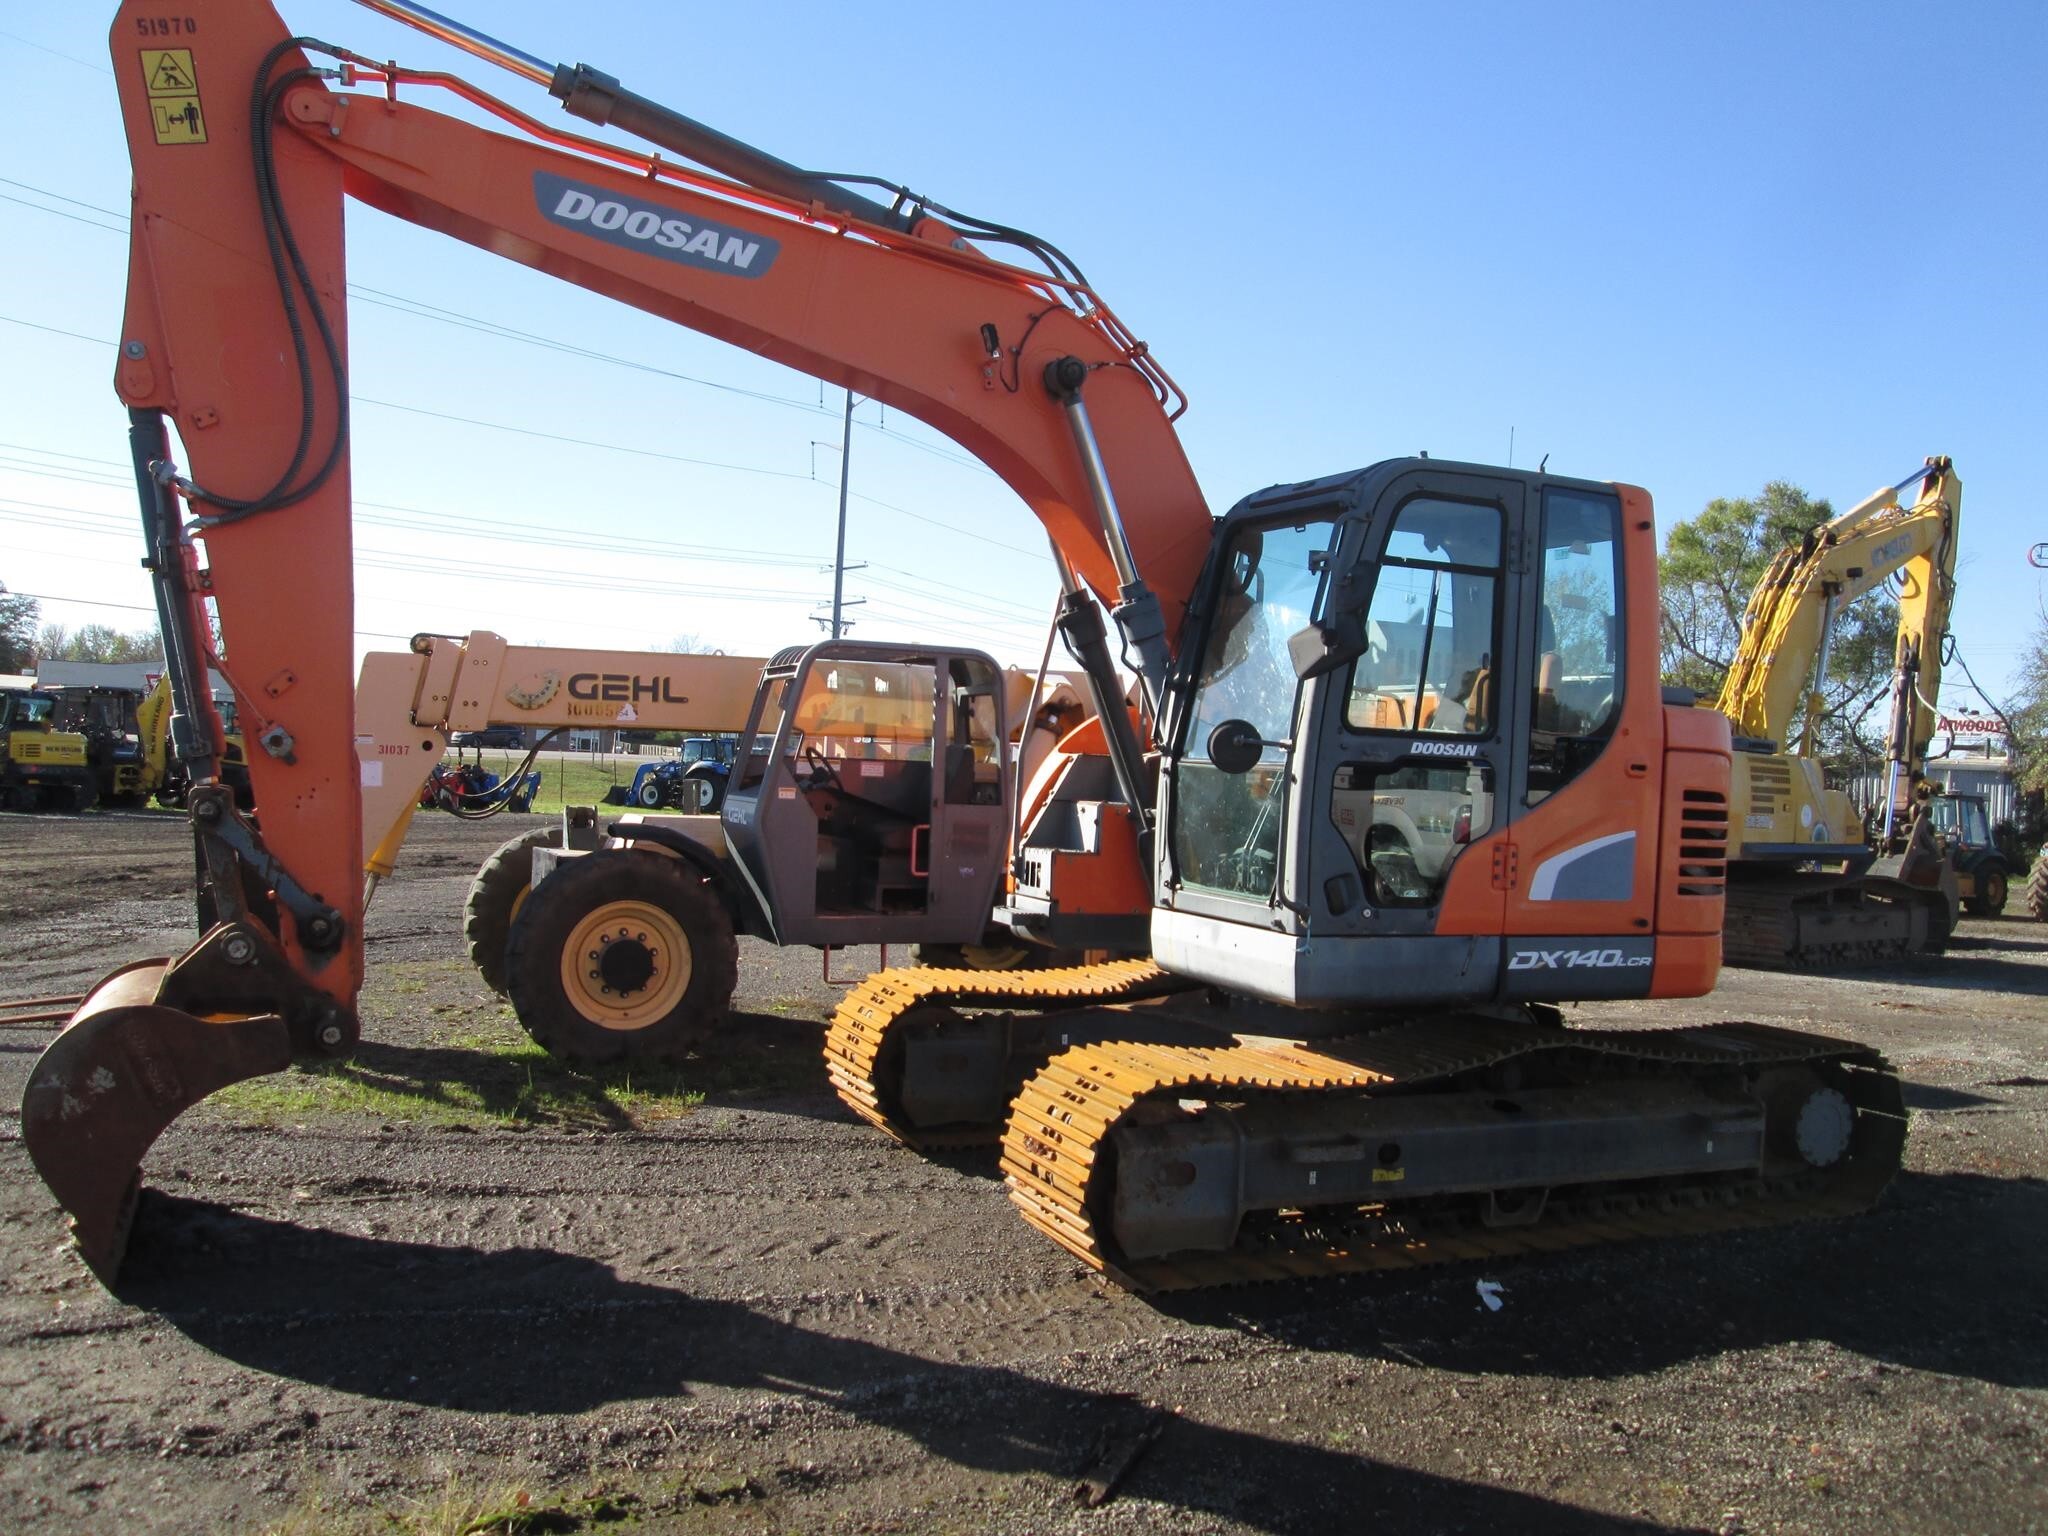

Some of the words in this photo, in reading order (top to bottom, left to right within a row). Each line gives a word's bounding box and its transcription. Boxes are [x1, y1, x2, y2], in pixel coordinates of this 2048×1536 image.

[136, 17, 197, 36] 51970
[554, 189, 760, 269] DOOSAN
[567, 673, 689, 703] GEHL
[378, 744, 410, 756] 31037
[1410, 742, 1478, 757] DOOSAN
